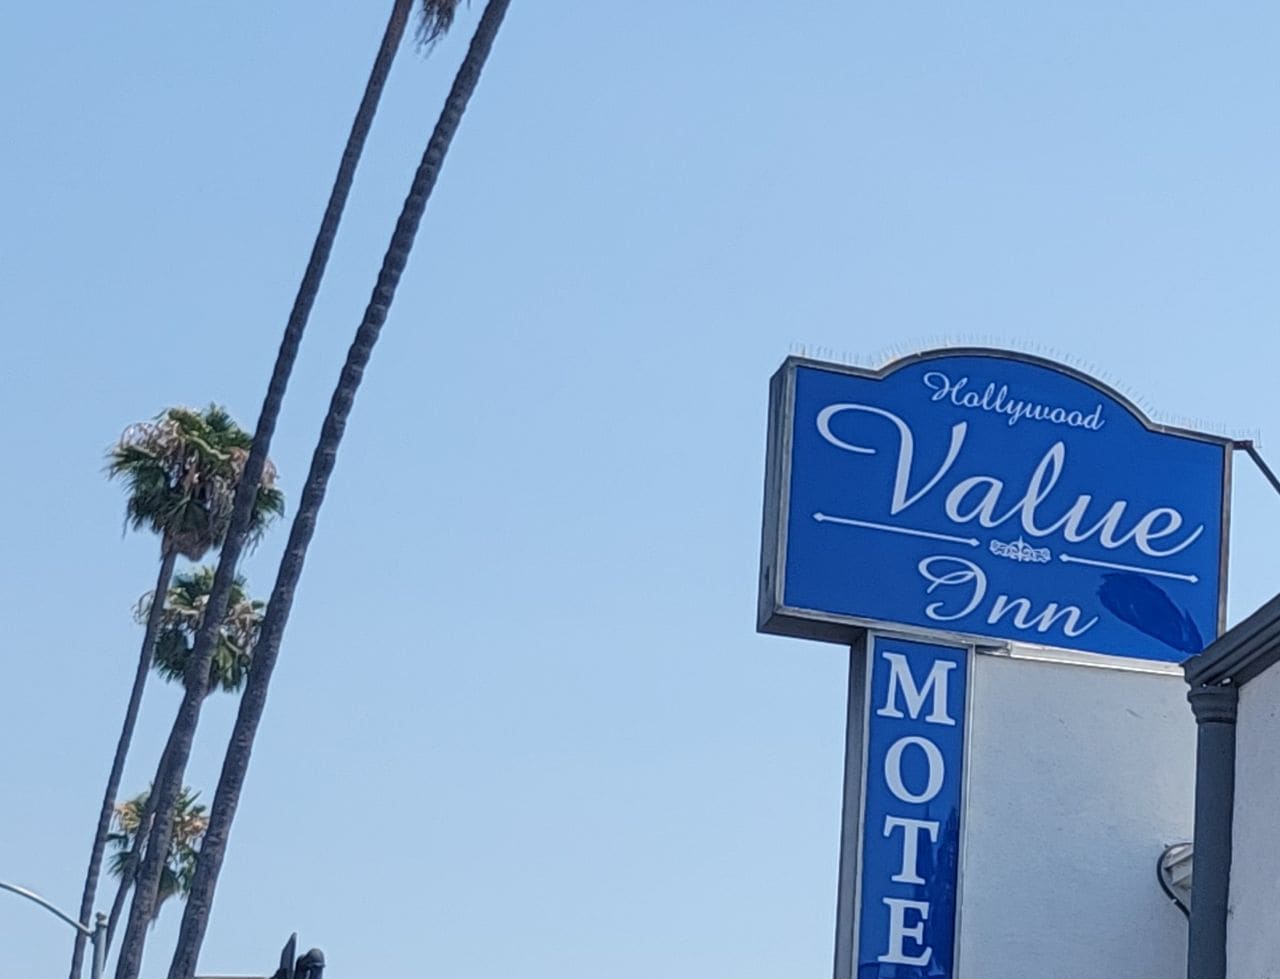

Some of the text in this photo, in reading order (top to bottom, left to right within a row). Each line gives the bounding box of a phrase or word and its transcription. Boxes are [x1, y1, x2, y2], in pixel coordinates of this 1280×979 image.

[923, 371, 1105, 431] Hollywood
[816, 403, 1204, 558] Value
[917, 555, 1099, 638] Inn
